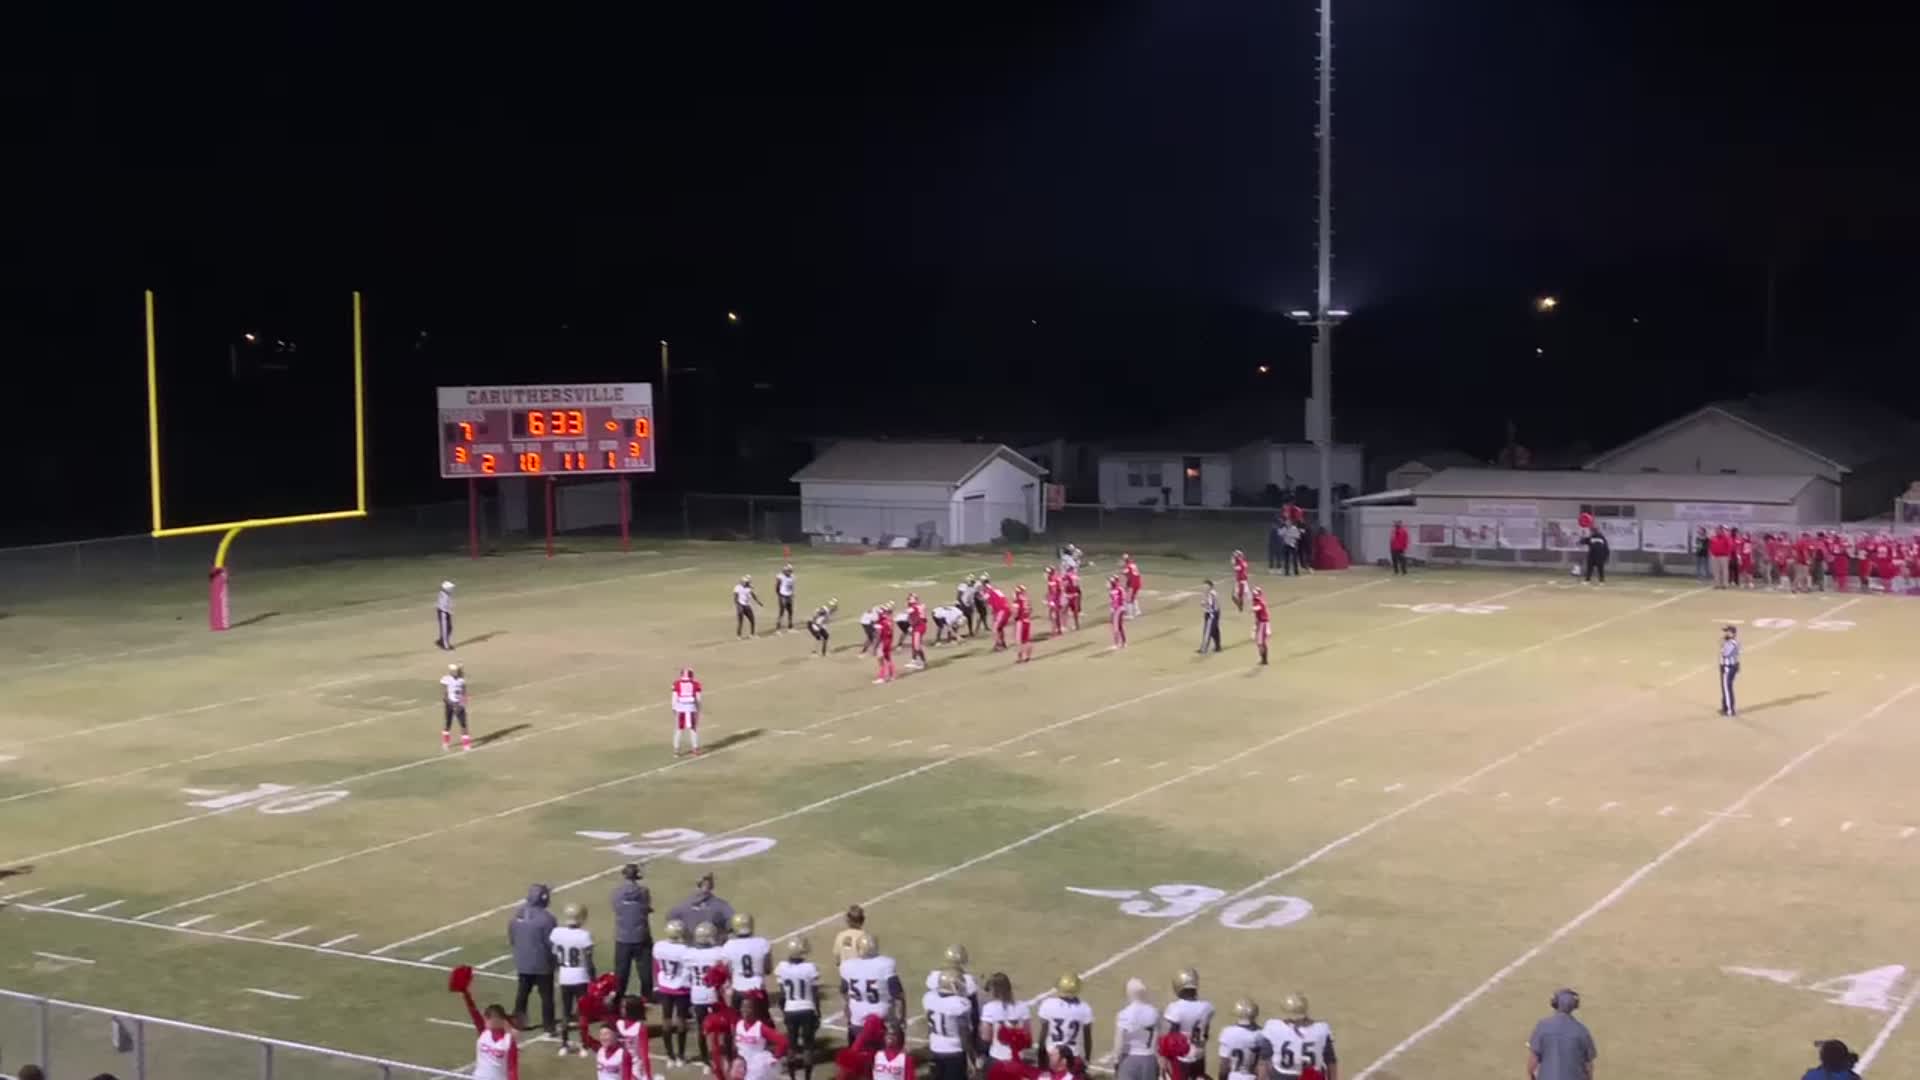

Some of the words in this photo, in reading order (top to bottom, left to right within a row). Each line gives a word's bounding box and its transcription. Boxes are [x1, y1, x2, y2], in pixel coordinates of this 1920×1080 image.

[467, 387, 624, 404] CARUTHERSVILLE
[459, 420, 474, 441] 7
[635, 417, 649, 438] 0
[455, 446, 468, 464] 3
[629, 441, 641, 458] 3
[480, 454, 497, 474] 2
[520, 452, 542, 473] 10
[563, 451, 586, 471] 11
[607, 451, 618, 470] 1
[182, 783, 350, 814] 10
[600, 828, 777, 863] 20
[1117, 884, 1313, 929] 30
[849, 978, 881, 1004] 55
[927, 1009, 948, 1037] 51
[1052, 1018, 1081, 1046] 32
[1280, 1041, 1316, 1069] 65
